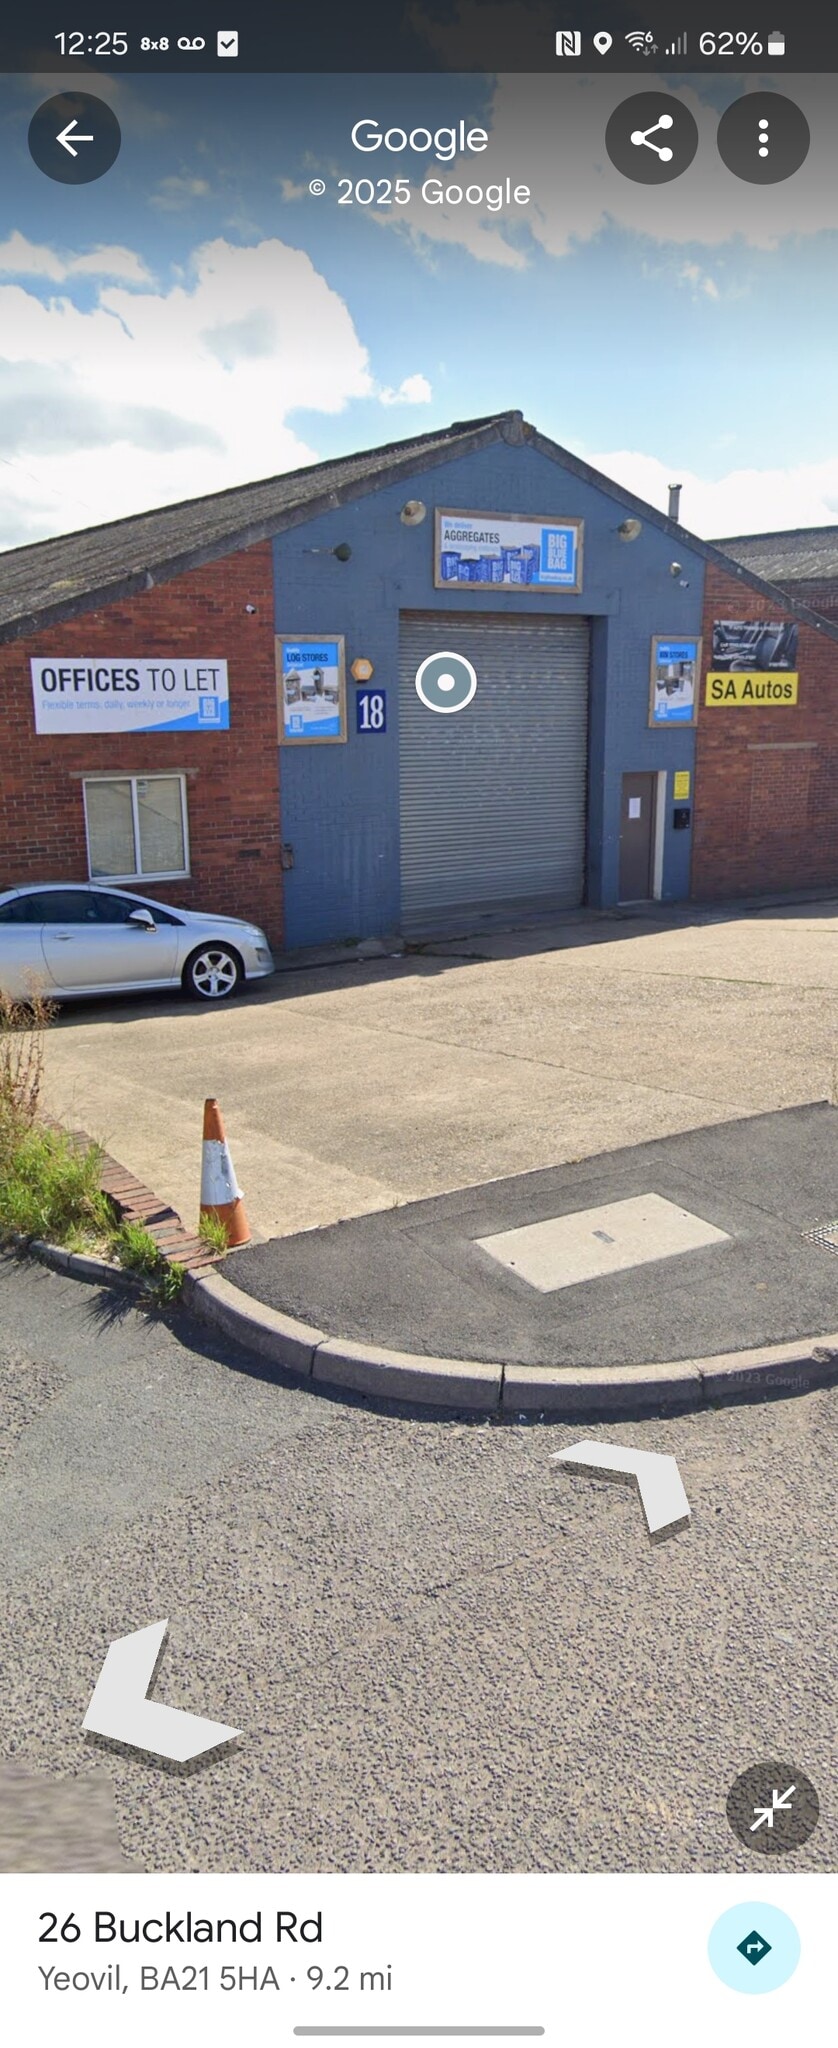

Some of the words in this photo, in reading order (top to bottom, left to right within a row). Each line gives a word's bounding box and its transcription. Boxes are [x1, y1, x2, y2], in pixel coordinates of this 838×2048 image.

[444, 530, 500, 544] AGGREGATES
[547, 534, 567, 548] BIG
[547, 547, 567, 559] BLUE
[547, 558, 567, 570] BAG
[286, 653, 301, 663] LOG
[302, 653, 329, 663] STORES
[41, 668, 140, 692] OFFICES
[146, 668, 176, 691] TO
[184, 669, 220, 691] LET
[711, 679, 737, 699] SA
[741, 679, 793, 699] Autos
[41, 700, 74, 710] Flexible
[126, 700, 154, 711] weekly
[166, 700, 191, 711] longer
[359, 695, 384, 729] 18
